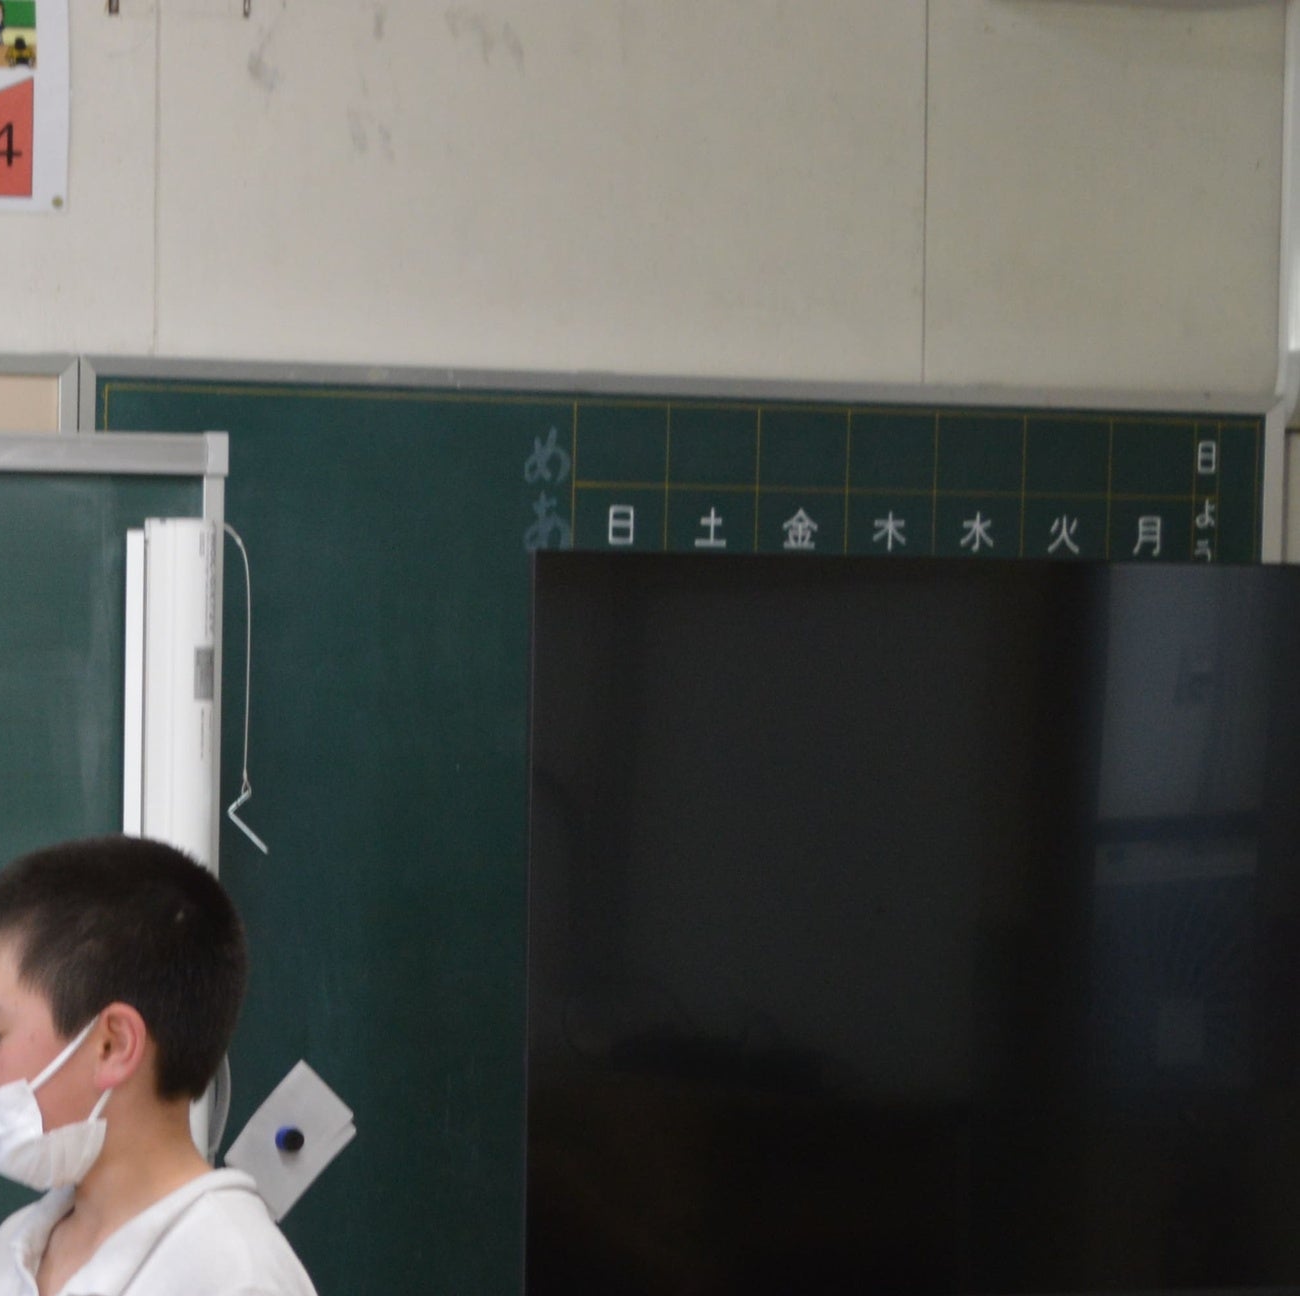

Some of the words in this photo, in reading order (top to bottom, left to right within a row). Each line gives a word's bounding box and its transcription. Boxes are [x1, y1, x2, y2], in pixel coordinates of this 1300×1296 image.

[608, 504, 634, 545] 日
[694, 506, 727, 549] 土
[783, 507, 818, 549] 金
[872, 510, 906, 552] 木
[960, 510, 994, 552] 水
[1047, 514, 1080, 554] 火
[1132, 515, 1161, 557] 月
